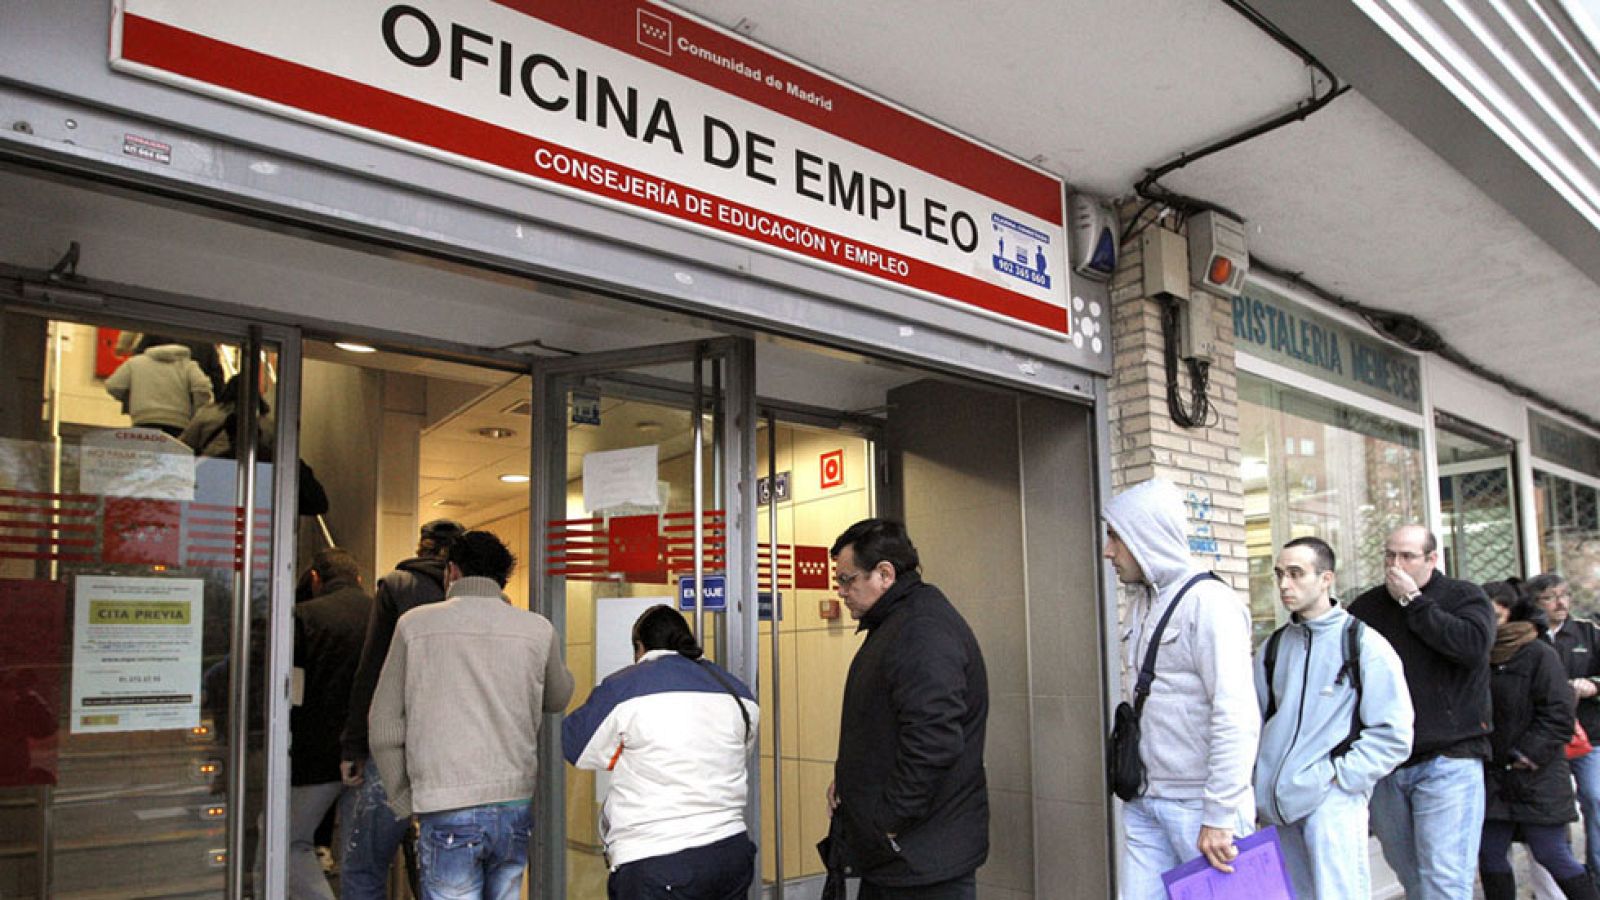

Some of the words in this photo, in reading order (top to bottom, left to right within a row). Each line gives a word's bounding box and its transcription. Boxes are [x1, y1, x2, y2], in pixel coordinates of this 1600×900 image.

[677, 37, 762, 81] Comunidad
[765, 74, 783, 91] de
[786, 80, 832, 111] Madrid
[381, 4, 684, 155] OFICINA
[703, 114, 777, 186] DE
[795, 148, 979, 254] EMPLEO
[534, 148, 680, 208] CONSEJERÍA
[685, 193, 713, 218] DE
[717, 203, 827, 253] EDUCACIÓN
[830, 238, 841, 256] Y
[844, 244, 910, 278] EMPLEO
[115, 431, 169, 443] CERRADO
[97, 608, 129, 620] CITA
[135, 608, 184, 620] PREVIA
